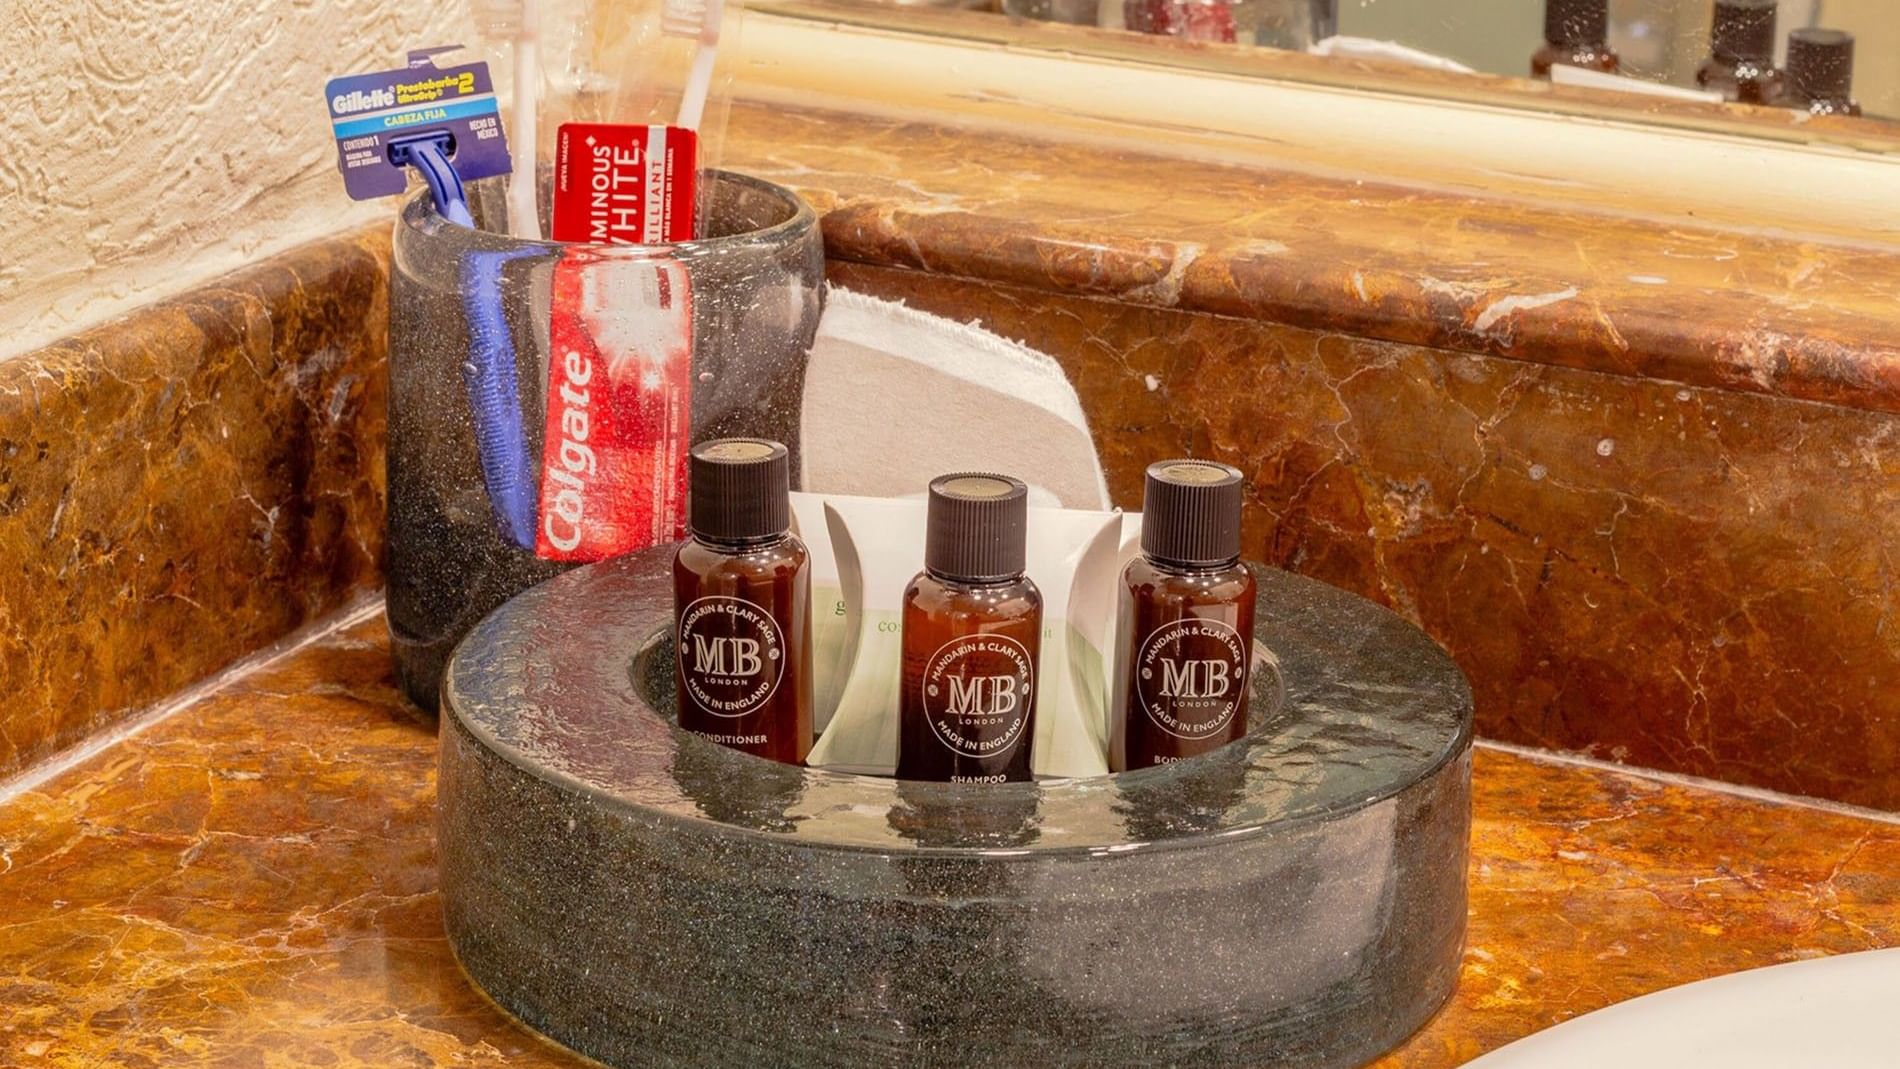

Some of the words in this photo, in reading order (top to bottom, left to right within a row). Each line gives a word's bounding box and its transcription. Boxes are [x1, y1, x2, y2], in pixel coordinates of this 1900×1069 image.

[332, 88, 395, 114] Gillette
[396, 76, 459, 95] Prestobarba
[384, 111, 424, 127] CABEZA
[424, 108, 447, 122] FIJA
[469, 118, 488, 131] HECHO
[487, 117, 496, 127] EN
[544, 351, 596, 553] Colgate
[683, 604, 716, 639] MANDARIN
[717, 604, 724, 613] &
[726, 604, 760, 623] CLARY
[756, 619, 776, 645] SAGE
[693, 633, 763, 677] MB
[1145, 626, 1190, 665] MANDARIN
[1191, 626, 1200, 636] &
[1200, 627, 1231, 644] CLARY
[1227, 639, 1241, 664] SAGE
[931, 642, 977, 682] MANDARIN
[978, 642, 987, 652] &
[987, 642, 1020, 662] CLARY
[1015, 655, 1028, 679] SAGE
[1158, 656, 1230, 699] MB
[689, 677, 711, 705] MADE
[711, 699, 723, 710] IN
[725, 681, 770, 711] ENGLAND
[704, 676, 748, 686] LONDON
[945, 673, 1017, 716] MB
[1151, 703, 1177, 728] MADE
[1178, 722, 1191, 732] IN
[1193, 701, 1235, 733] ENGLAND
[1172, 700, 1217, 708] LONDON
[937, 719, 964, 747] MADE
[964, 740, 978, 751] IN
[980, 717, 1022, 751] ENGLAND
[958, 716, 1004, 726] LONDON
[1154, 755, 1185, 764] BOD
[950, 774, 1007, 784] SHAMPOO
